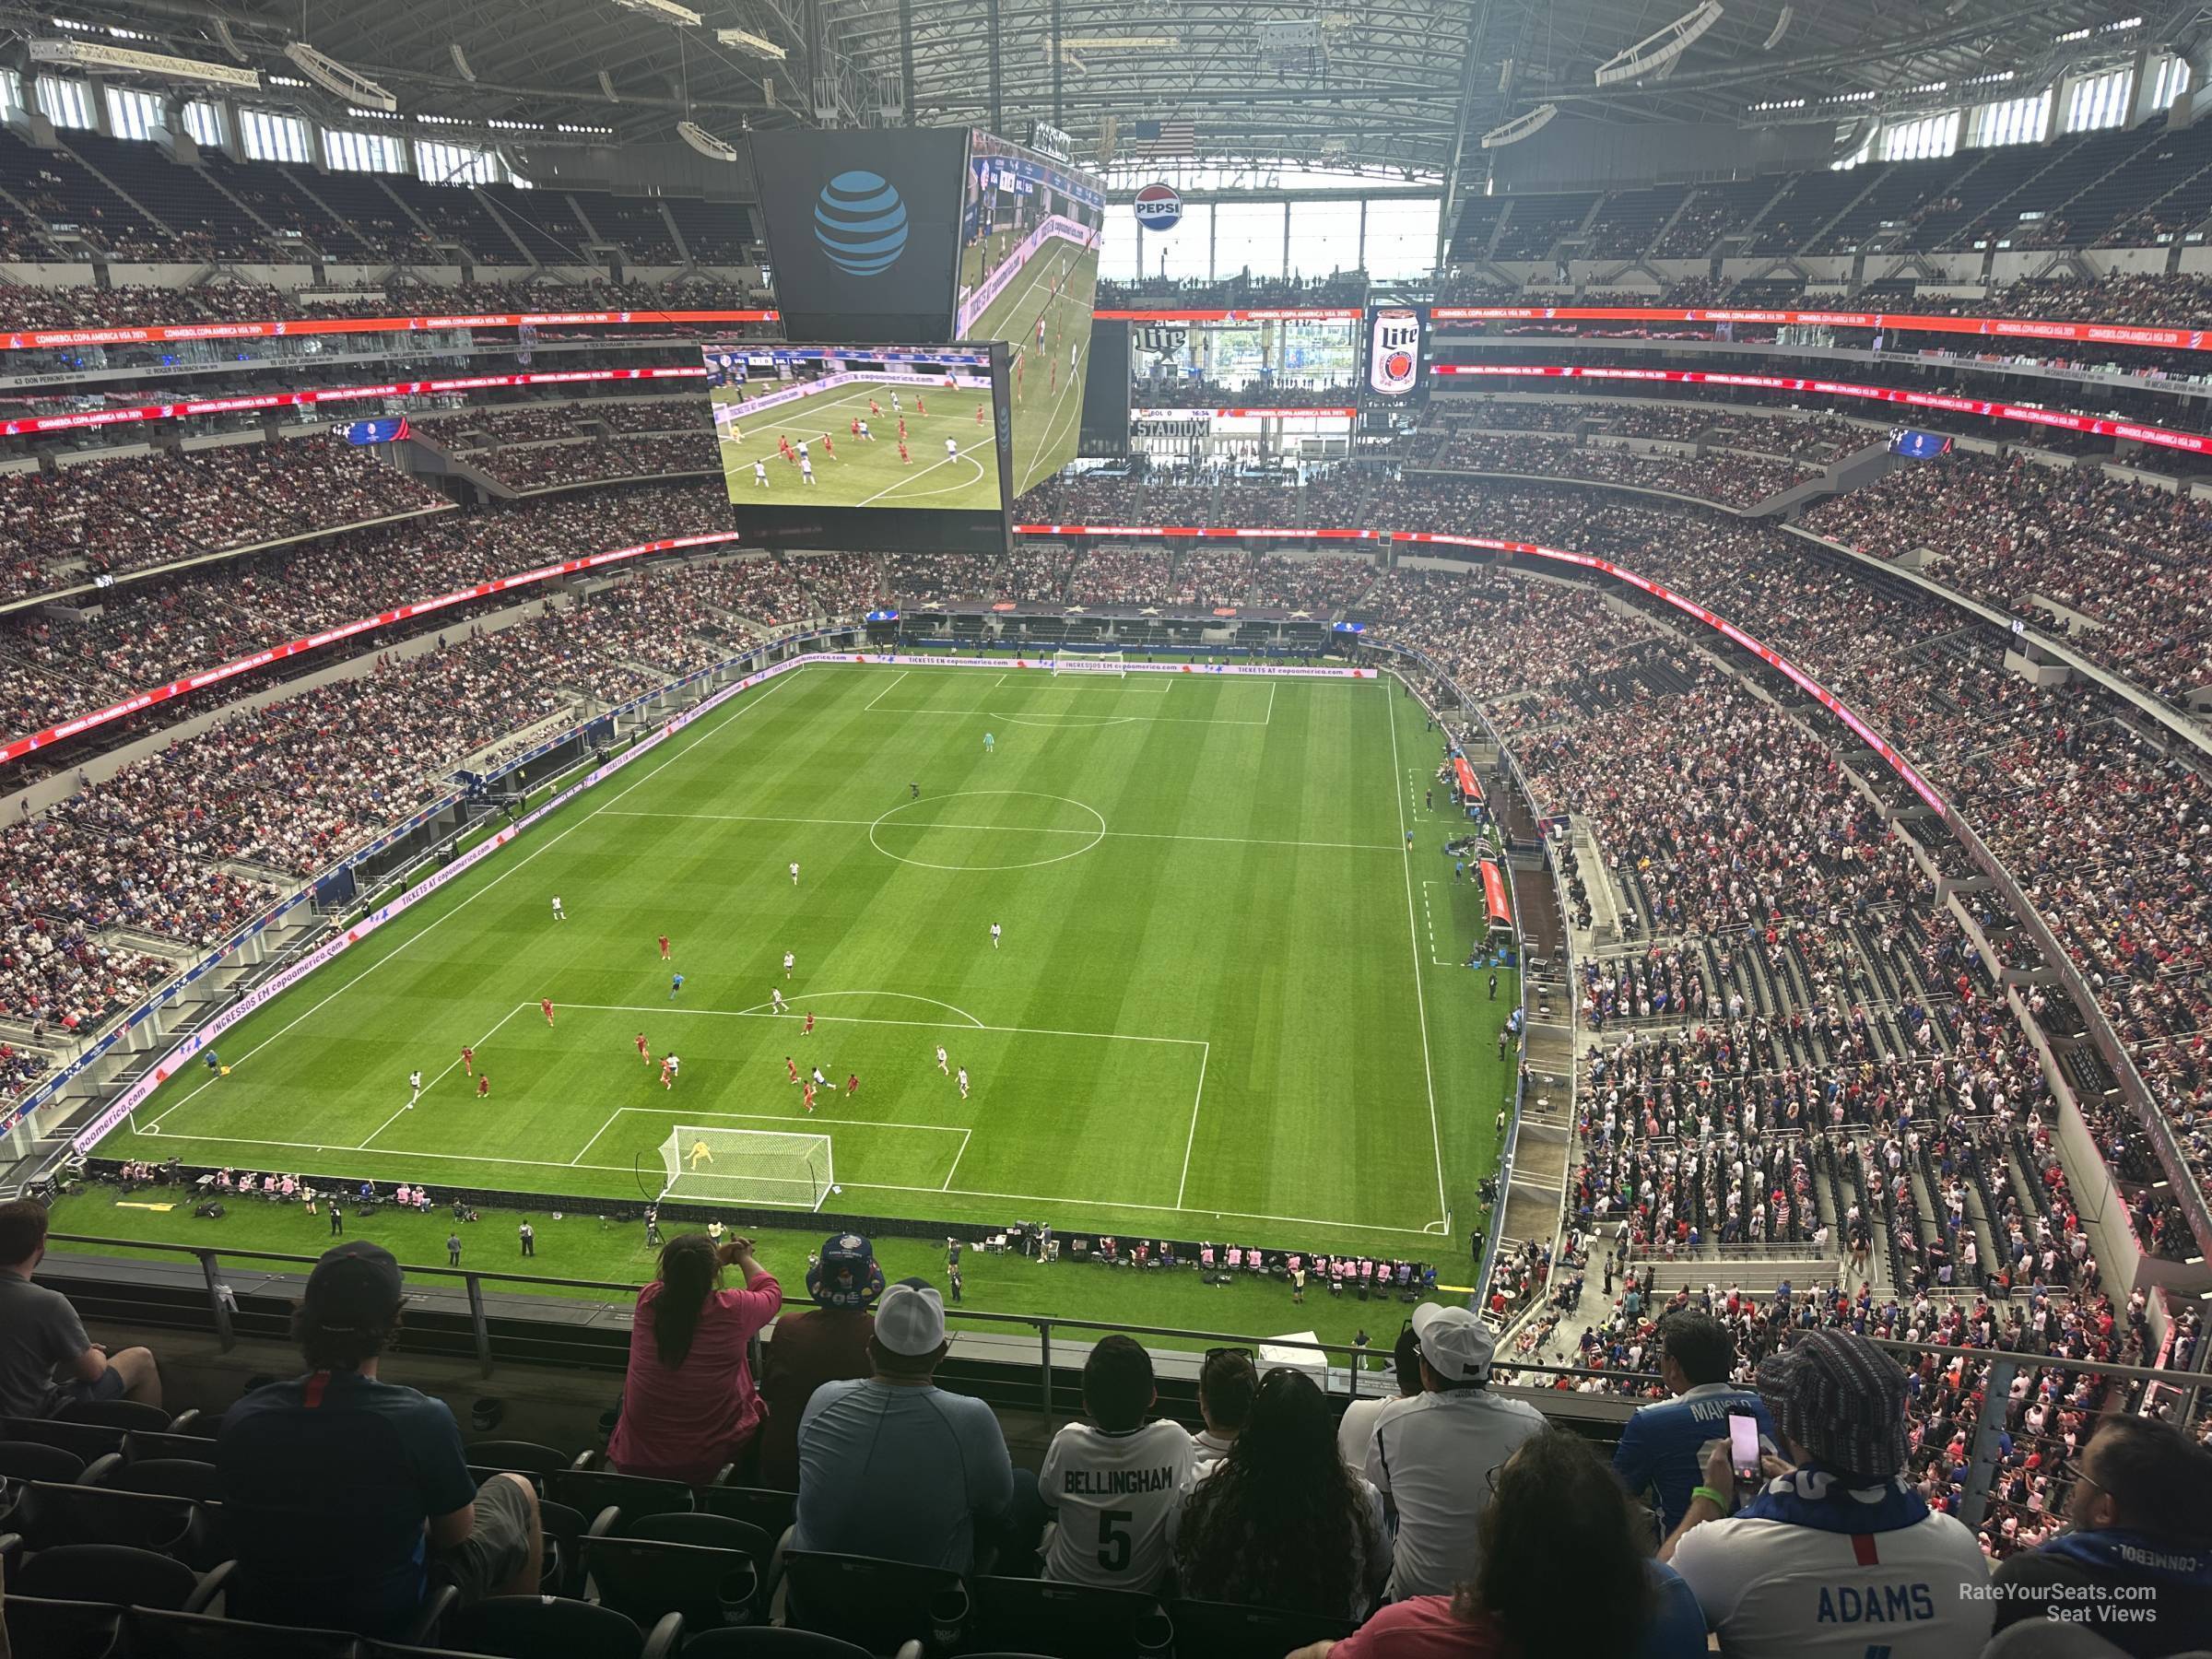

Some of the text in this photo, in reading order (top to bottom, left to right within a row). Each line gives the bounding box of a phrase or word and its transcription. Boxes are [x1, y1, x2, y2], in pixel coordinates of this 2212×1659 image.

[1136, 203, 1180, 214] PEPSI
[426, 318, 451, 326] CONMEBOL
[1705, 311, 1730, 319] CONMEBOL
[1745, 312, 1765, 320] AMERICA
[1766, 312, 1774, 321] USA
[1821, 314, 1831, 323] COPA
[36, 329, 147, 344] CONMEBOL COPA AMERICA USA 2024
[164, 324, 263, 337] CONMEBOL COPA AMERICA USA 2024
[2021, 324, 2033, 334] COPA
[2088, 326, 2177, 344] CONMEBOL COPA AMERICA USA 2024
[1135, 326, 1186, 353] Lite
[1381, 326, 1418, 350] Lite
[15, 374, 65, 385] 43 DON PERKINS
[1137, 420, 1209, 437] STADIUM
[402, 883, 428, 905] TICKETS
[429, 878, 437, 888] AT
[213, 996, 256, 1034] INGRESSOS
[257, 988, 270, 1001] EM
[1065, 1465, 1173, 1495] BELLINGHAM
[1098, 1510, 1133, 1571] 5
[2120, 1544, 2196, 1571] CONMEBOL
[1818, 1583, 1934, 1623] ADAMS
